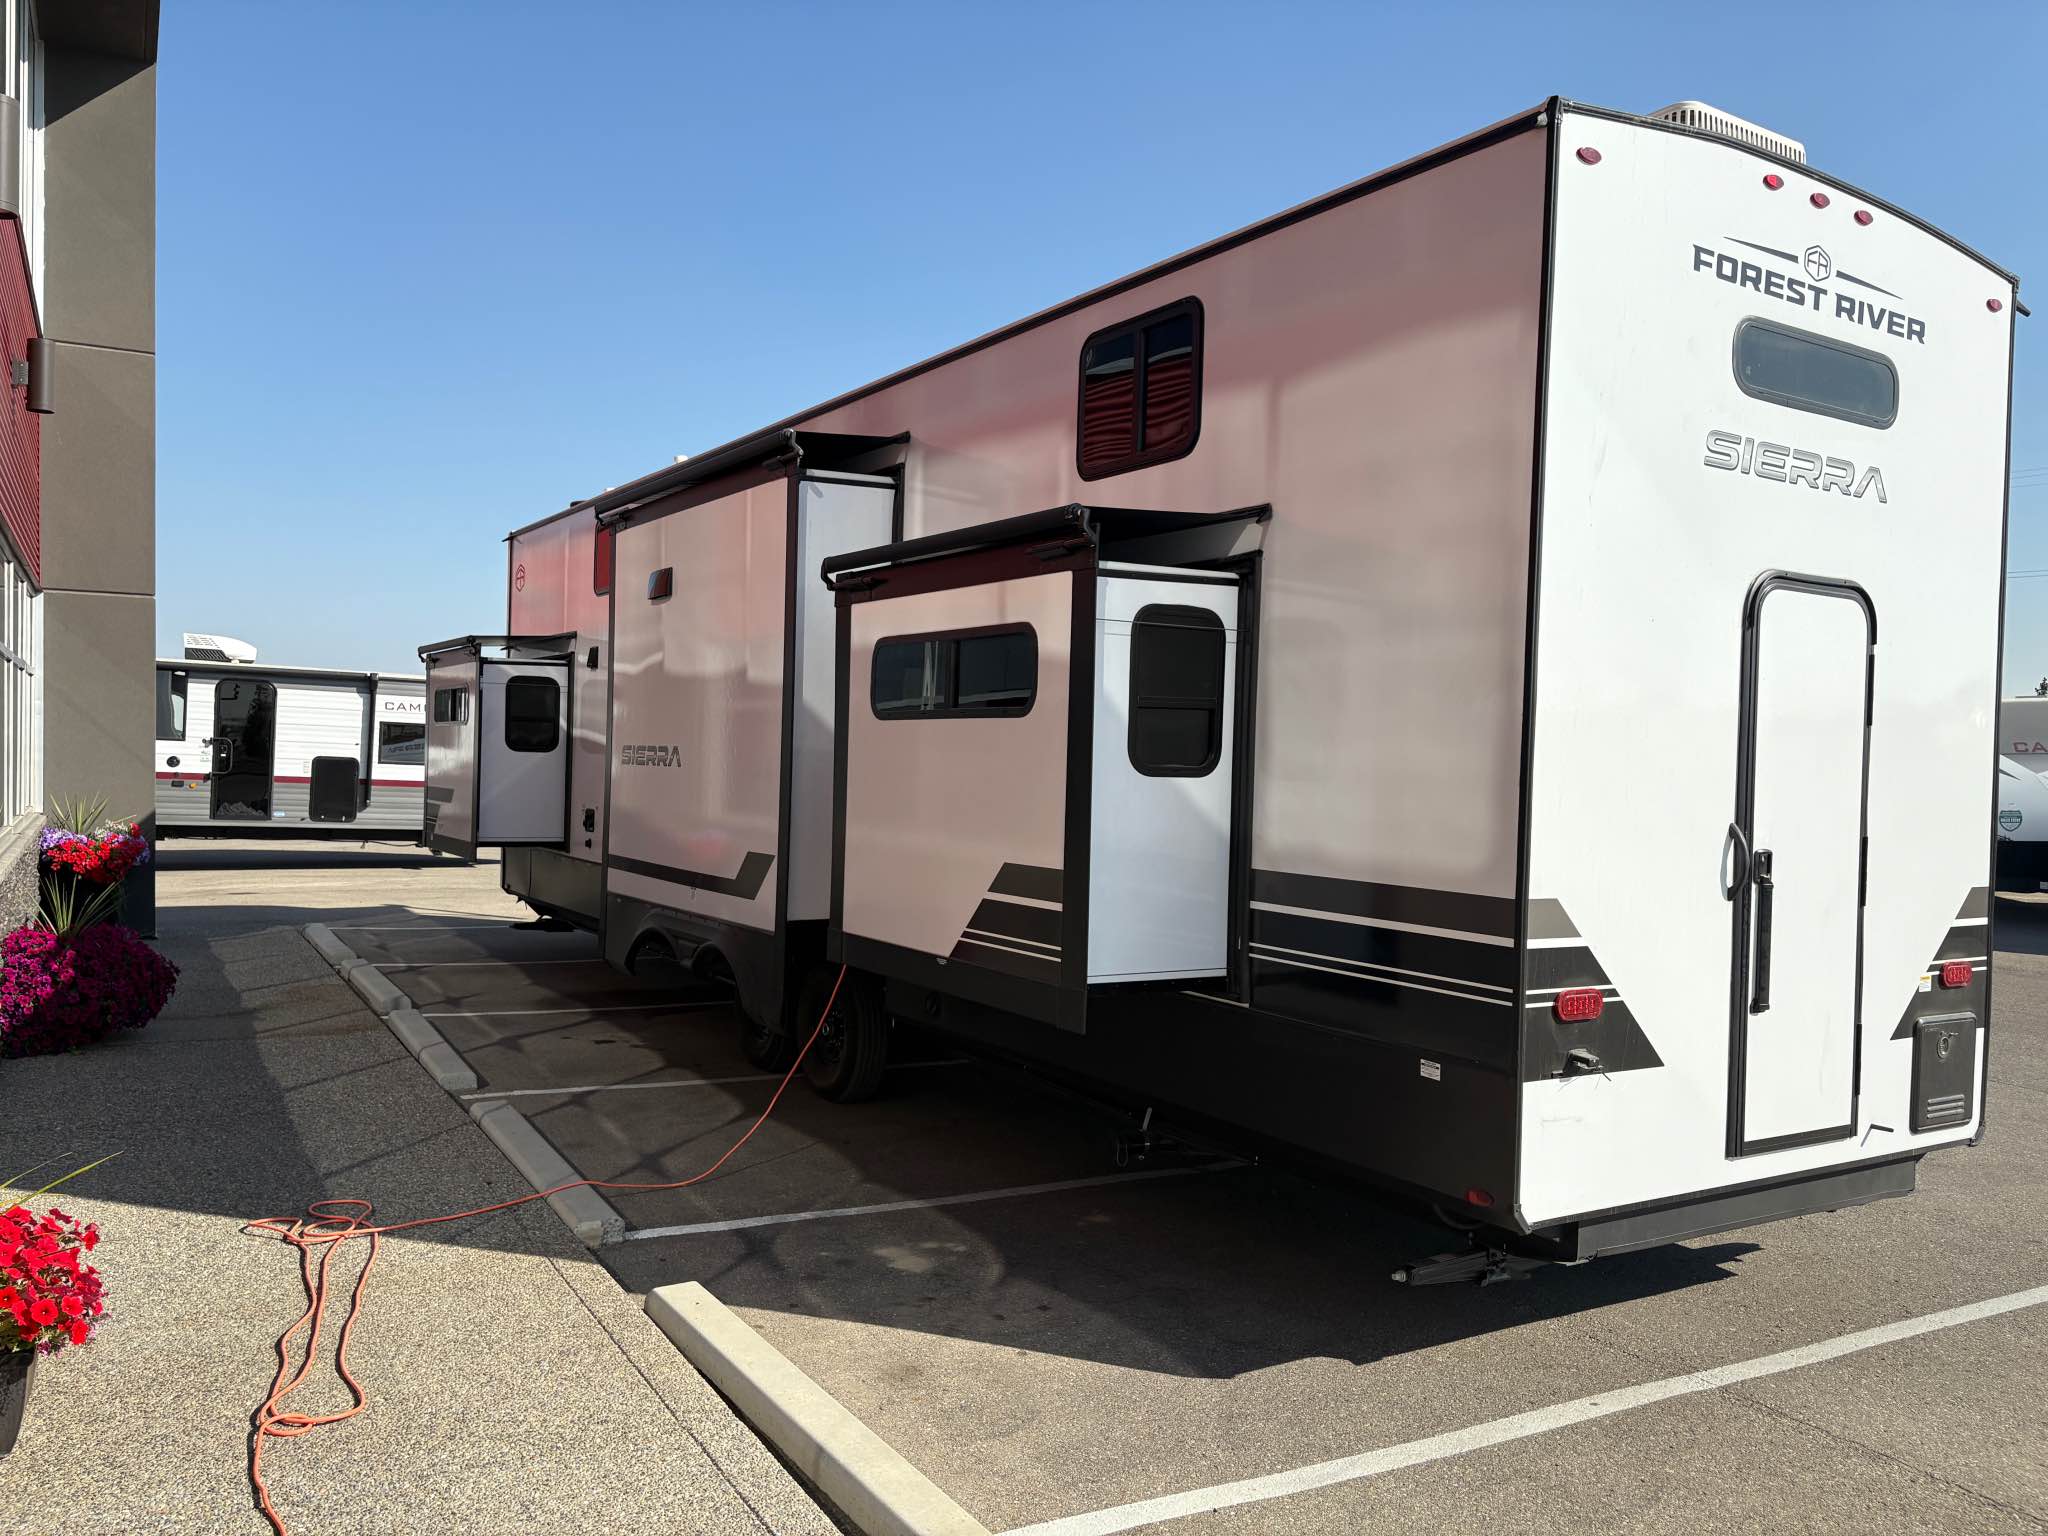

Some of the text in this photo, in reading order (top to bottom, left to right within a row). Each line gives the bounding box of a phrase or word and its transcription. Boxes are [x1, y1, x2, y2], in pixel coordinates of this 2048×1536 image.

[1693, 243, 1926, 345] FOREST RIVER
[1703, 429, 1888, 504] SIERRA
[384, 701, 426, 713] CAM
[621, 744, 682, 768] SIERRA
